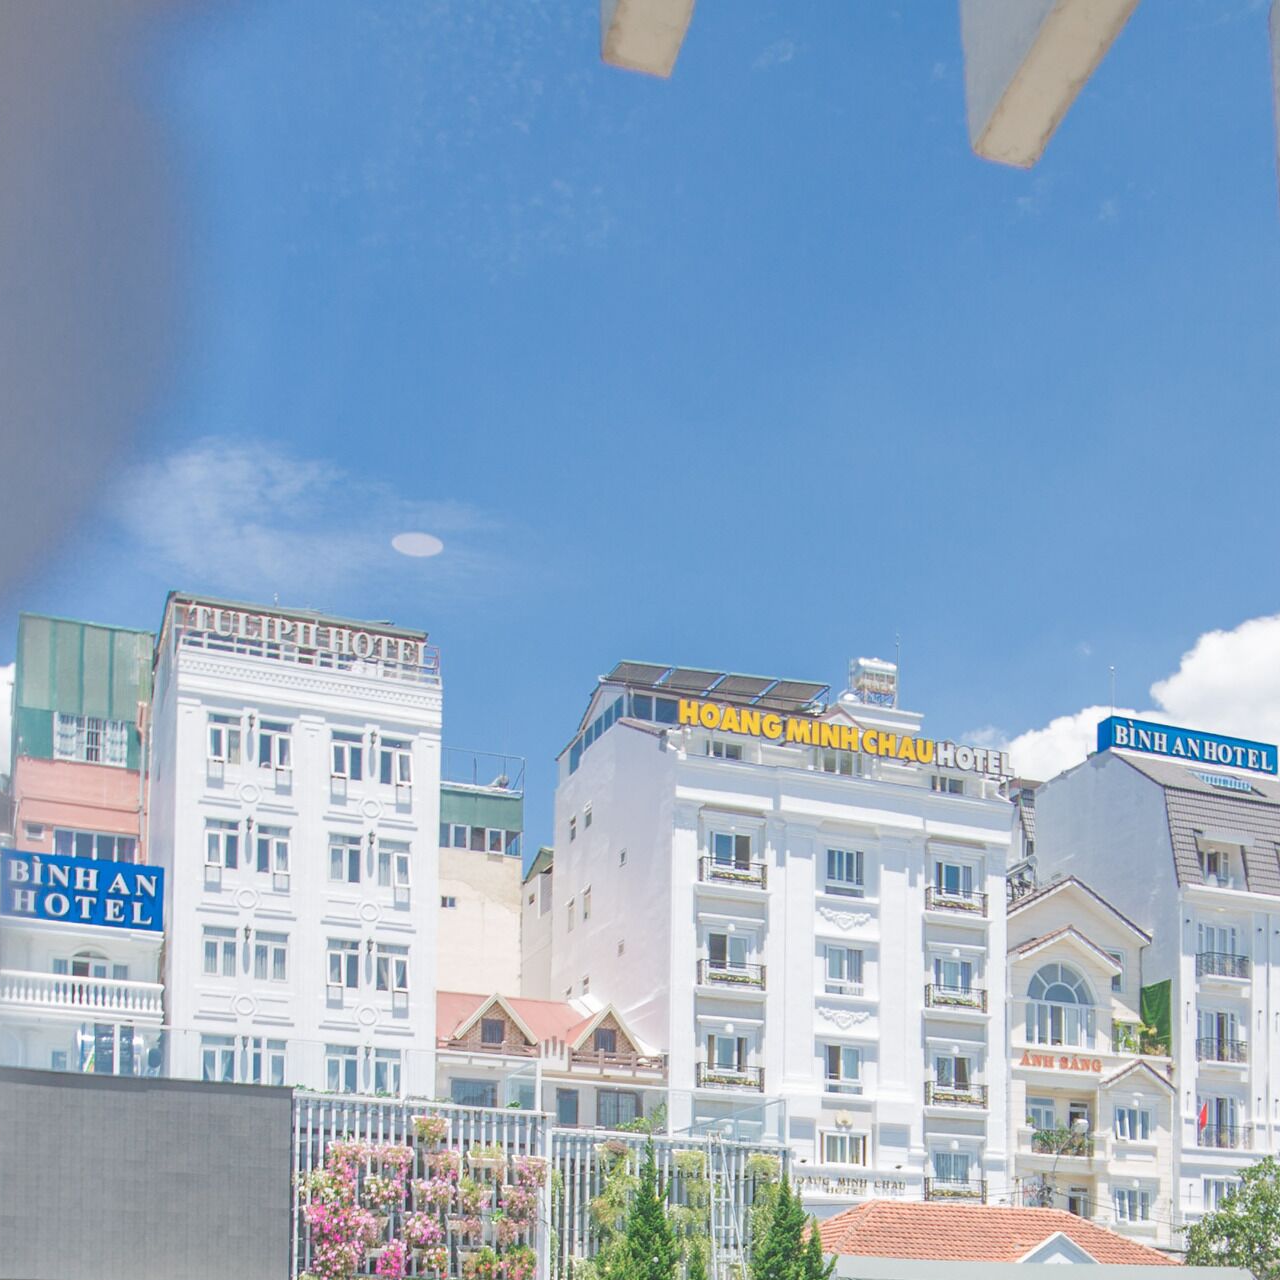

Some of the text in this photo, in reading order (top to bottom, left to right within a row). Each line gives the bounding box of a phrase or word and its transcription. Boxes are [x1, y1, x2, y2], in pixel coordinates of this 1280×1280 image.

[327, 626, 438, 669] HOTEL
[679, 698, 1015, 778] HOANG MINH CHAU HOTEL
[1115, 720, 1273, 771] BÌNH AN HOTEL
[9, 855, 158, 898] BÌNH AN
[13, 889, 153, 925] HOTEL
